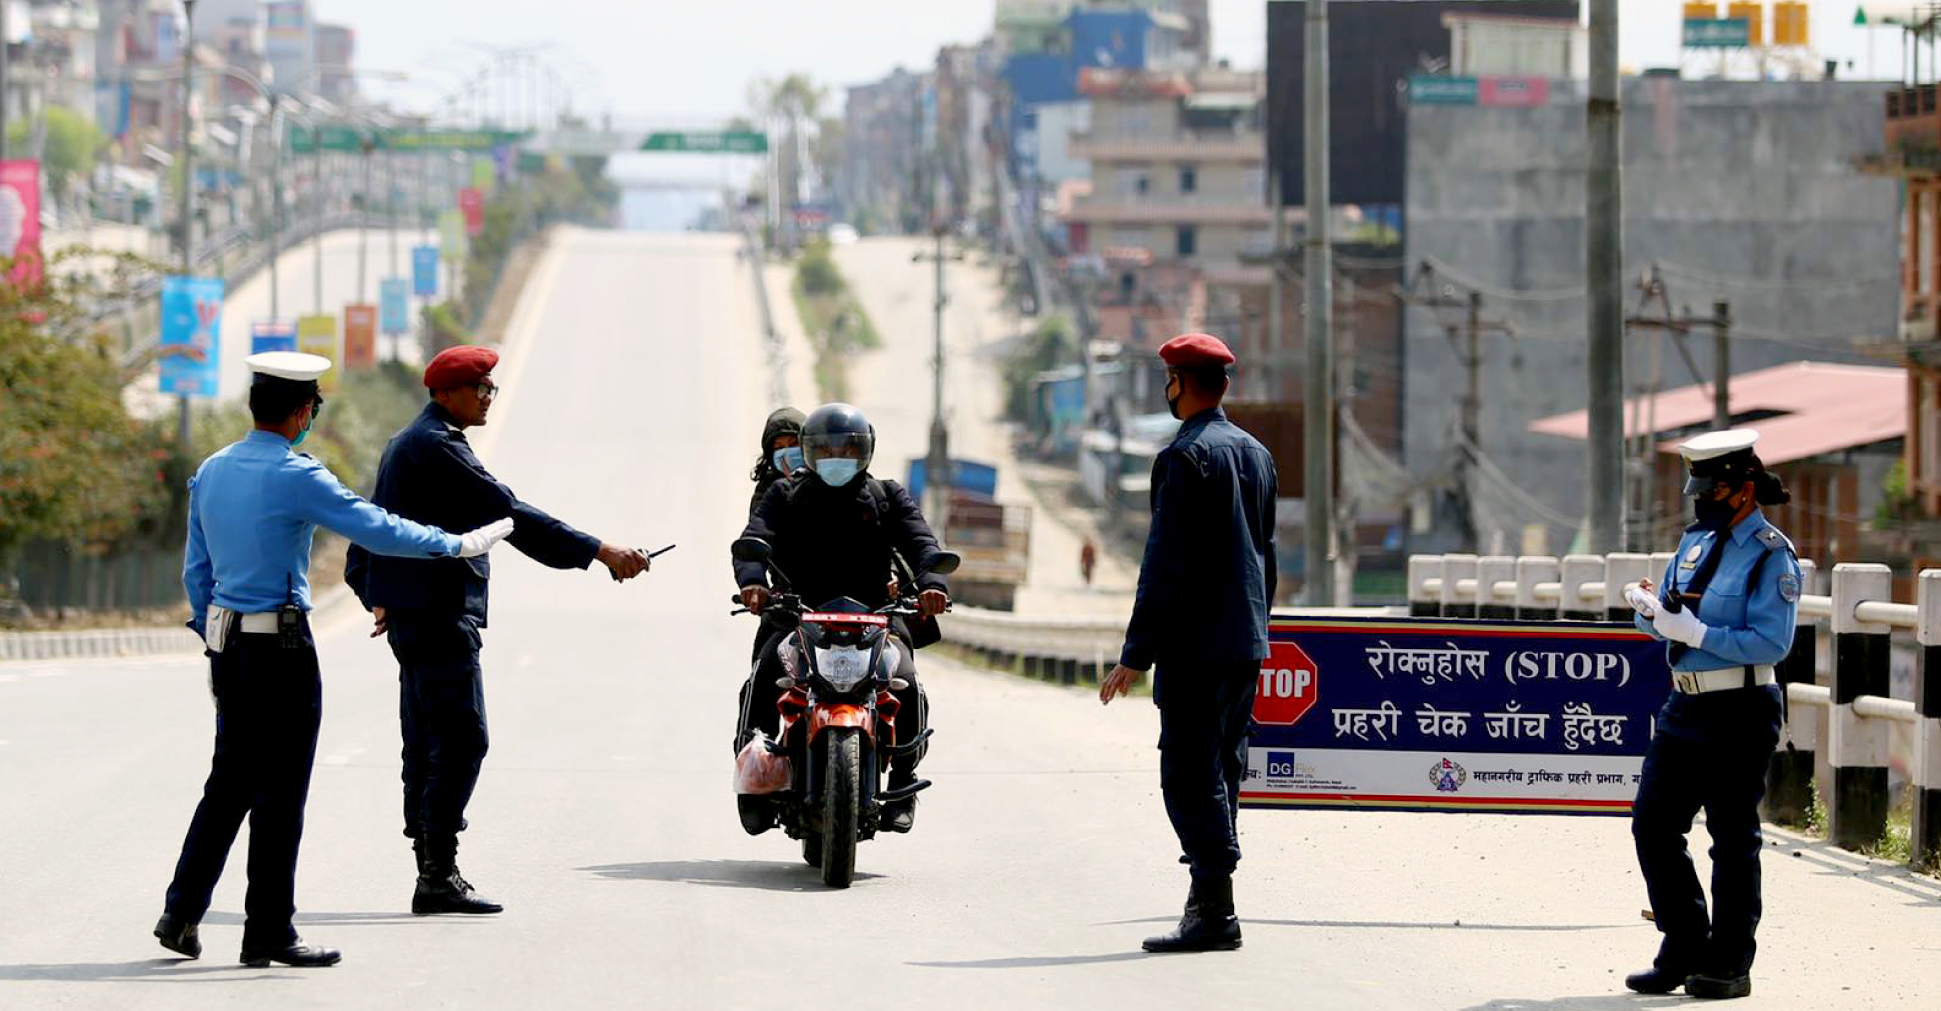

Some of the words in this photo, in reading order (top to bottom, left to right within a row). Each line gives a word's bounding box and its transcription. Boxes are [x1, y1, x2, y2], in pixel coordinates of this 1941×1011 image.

[1365, 640, 1489, 685] रोक्नुहोस
[1505, 651, 1630, 687] (STOP)
[1256, 668, 1311, 698] TOP
[1332, 700, 1403, 741] प्रहरी
[1415, 702, 1471, 738] चेक
[1484, 699, 1550, 739] जाँच
[1562, 701, 1628, 750] हुँदैछ
[1270, 762, 1291, 775] DG
[1473, 768, 1523, 784] महानगरीय
[1527, 769, 1563, 786] ट्राफिक
[1568, 770, 1592, 785] प्रहरी
